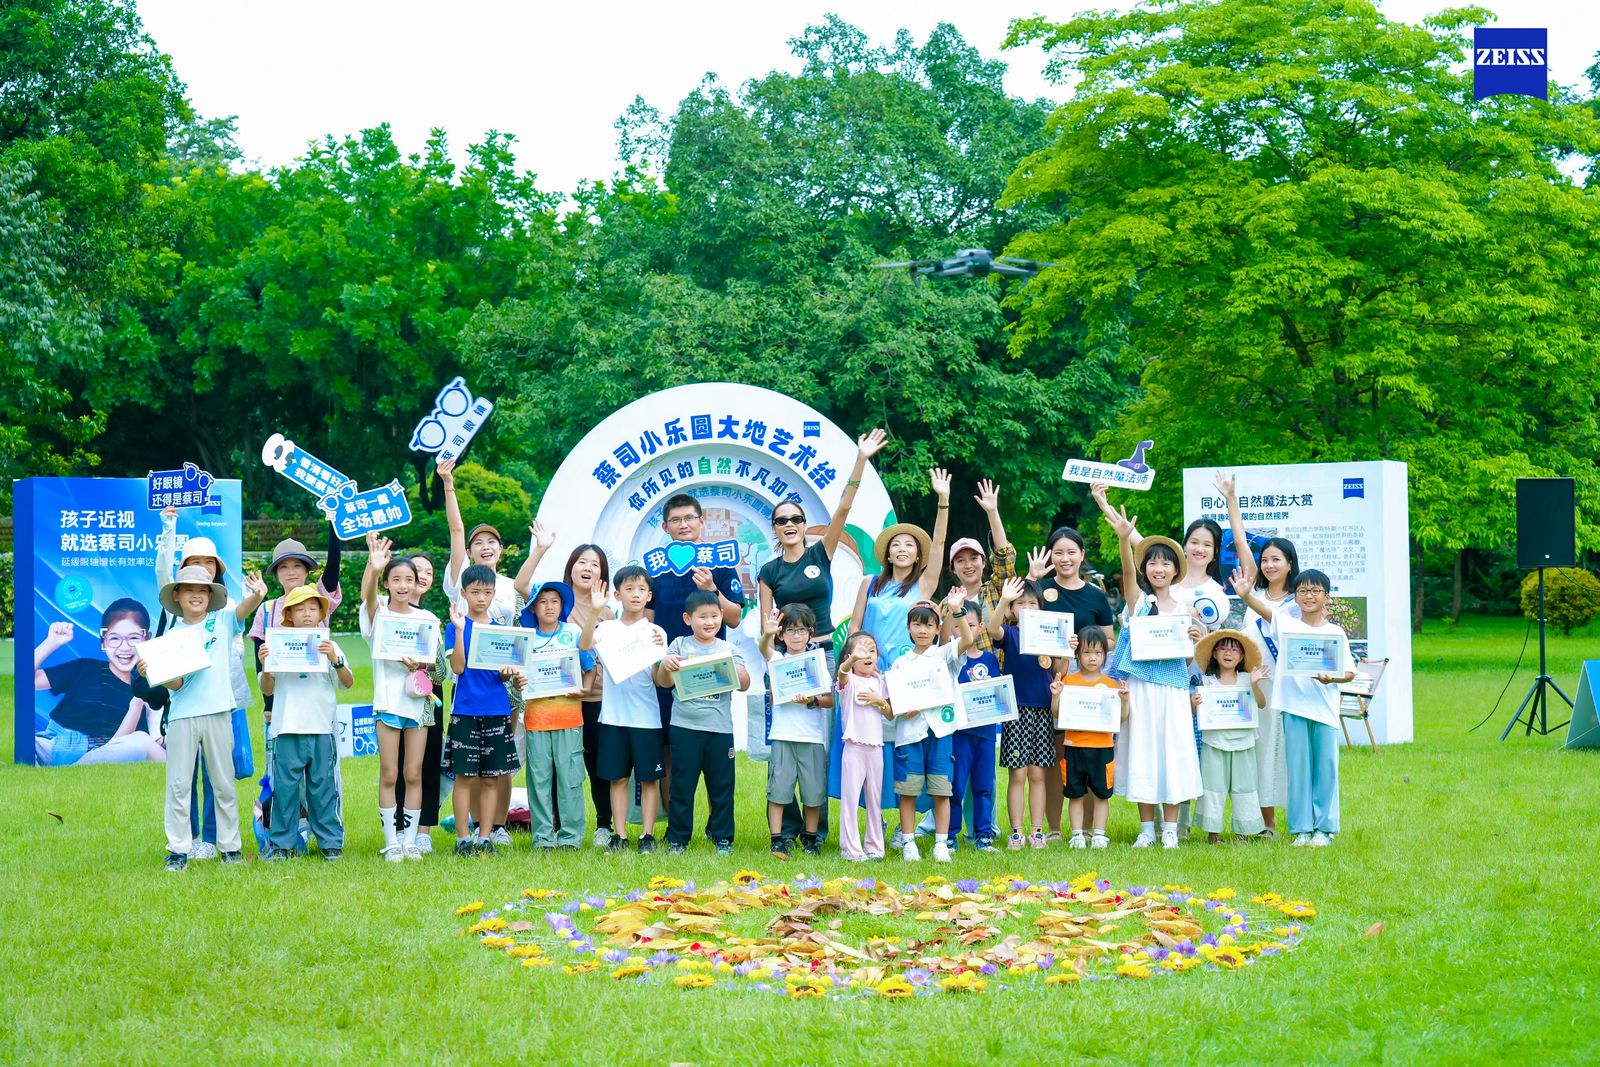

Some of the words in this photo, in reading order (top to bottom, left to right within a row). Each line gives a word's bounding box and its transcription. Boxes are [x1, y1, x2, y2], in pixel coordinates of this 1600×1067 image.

[591, 414, 837, 490] 蔡司小乐圆大地艺术绘
[152, 475, 183, 491] 好眼镜
[628, 456, 803, 511] 你所见的自然不凡如你
[1068, 464, 1149, 484] 我是自然魔法师
[152, 490, 203, 507] 还得是蔡司
[1201, 493, 1313, 509] 同心自然魔法大赏
[60, 509, 135, 529] 孩子近视
[341, 504, 403, 534] 全场最帅
[1201, 511, 1289, 522] 探寻趣限的自然视界
[647, 550, 668, 571] 我
[696, 543, 736, 564] 蔡司
